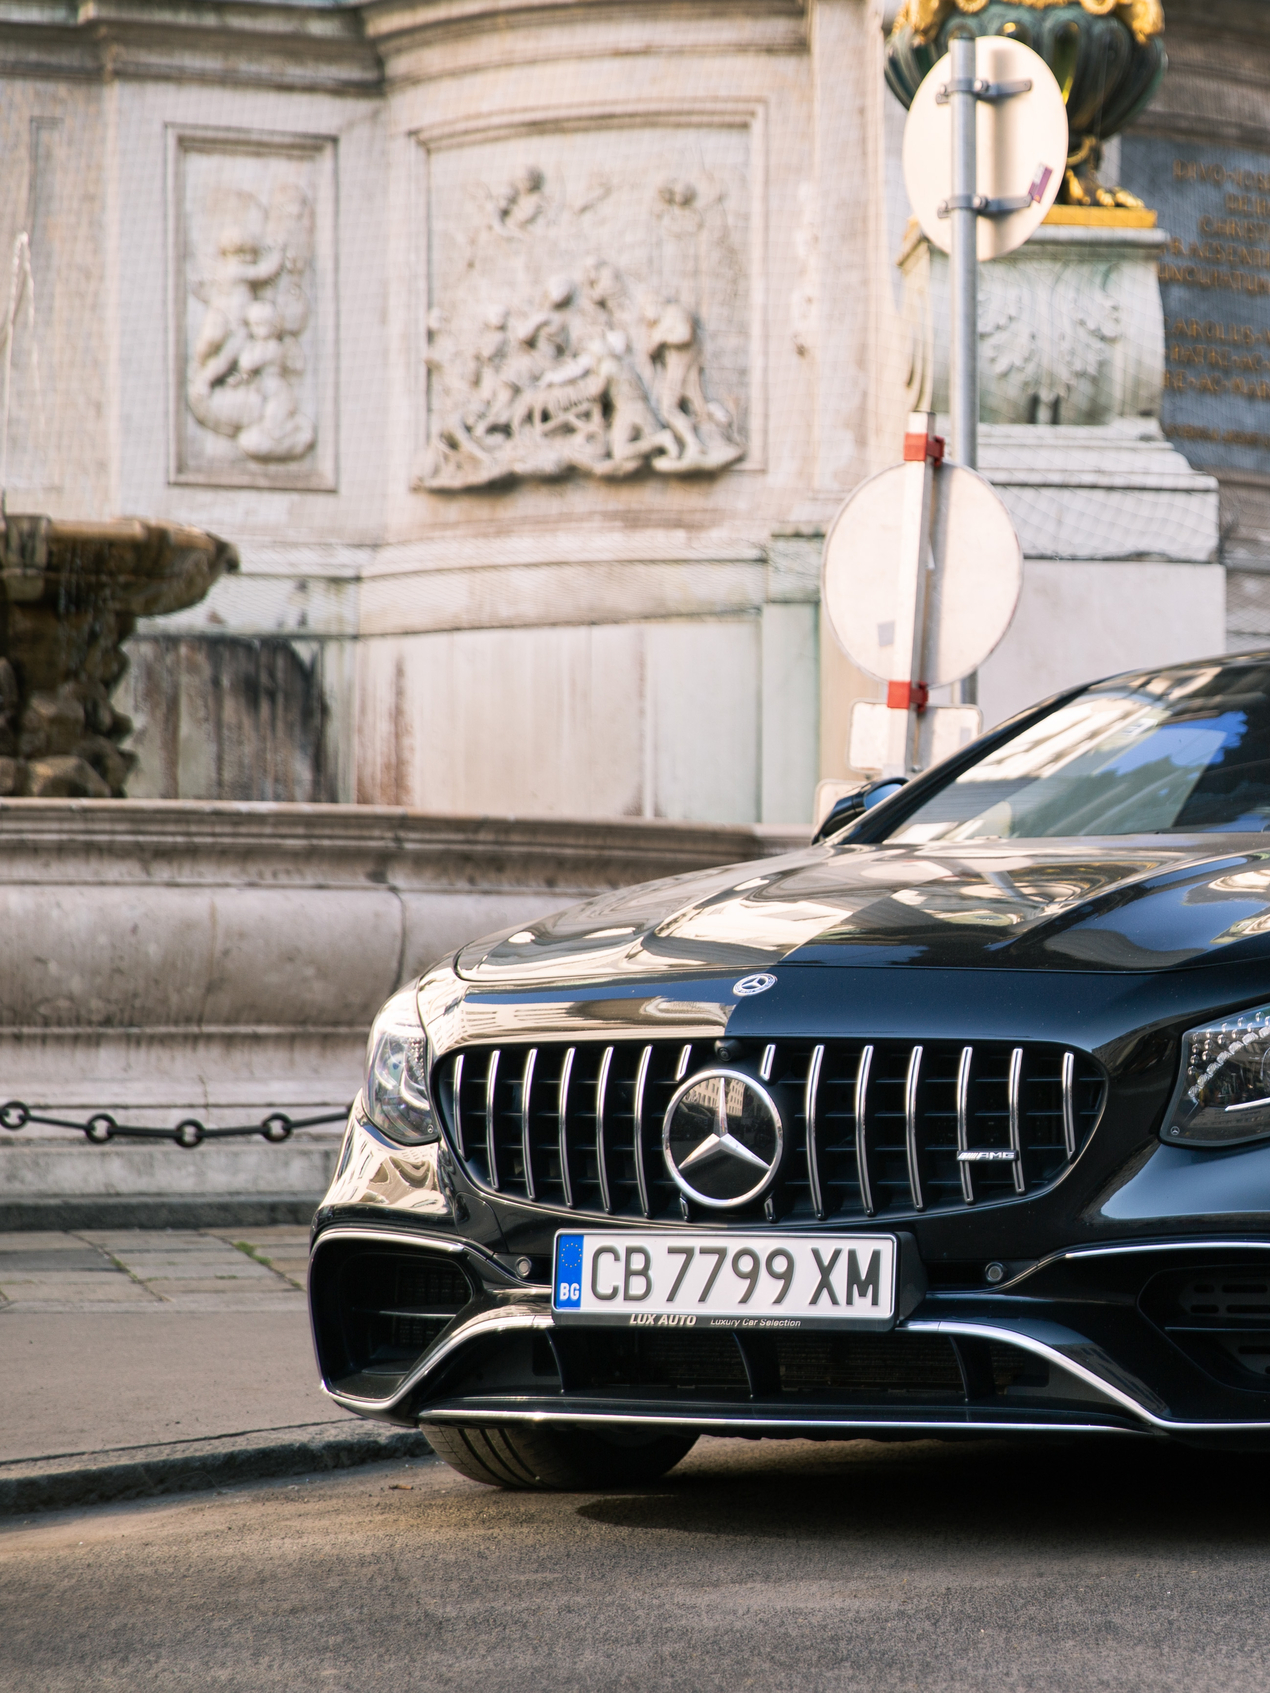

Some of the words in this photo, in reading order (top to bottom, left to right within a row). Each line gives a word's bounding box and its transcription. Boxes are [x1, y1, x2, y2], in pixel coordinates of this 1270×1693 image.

[977, 1152, 1015, 1160] AMG
[591, 1244, 653, 1302] CB
[666, 1245, 795, 1304] 7799
[808, 1247, 881, 1306] XM
[560, 1283, 580, 1301] BG
[629, 1313, 657, 1325] LUX
[658, 1314, 697, 1326] AUTO
[710, 1318, 740, 1328] Luxury
[742, 1318, 758, 1327] Car
[759, 1318, 801, 1327] Selection
